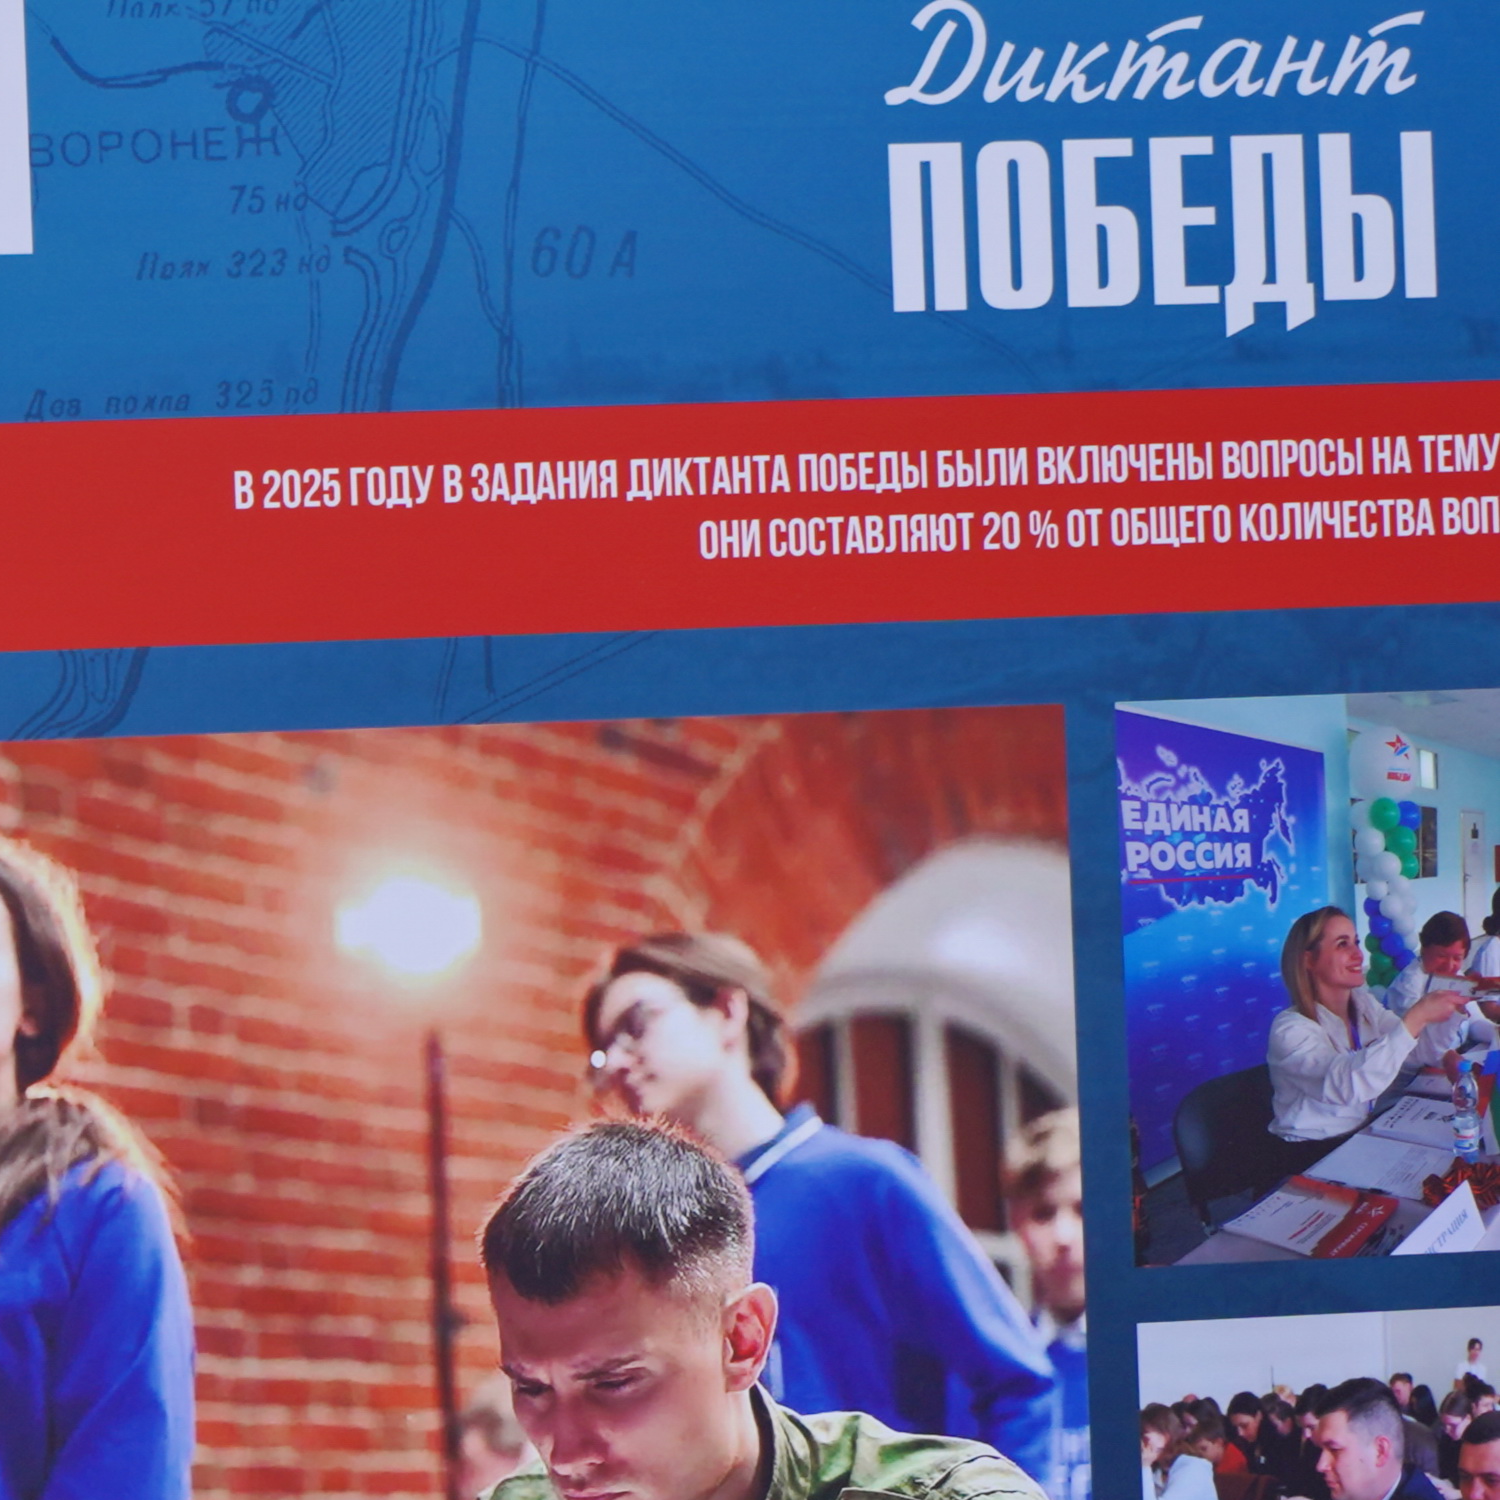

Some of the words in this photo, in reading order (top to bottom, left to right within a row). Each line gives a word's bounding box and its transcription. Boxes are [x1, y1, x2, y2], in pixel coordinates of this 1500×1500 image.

[883, 0, 1424, 106] Диктант
[29, 122, 283, 168] ВОРОНЕЖ
[229, 185, 265, 216] 75
[530, 225, 595, 280] 60
[887, 131, 1438, 338] ПОБЕДЫ
[227, 248, 287, 277] 323
[233, 470, 255, 510] В
[261, 467, 342, 509] 2025
[349, 464, 435, 509] ГОДУ
[442, 462, 465, 504] В
[470, 458, 619, 505] ЗАДАНИЯ
[626, 453, 791, 501] ДИКТАНТА
[797, 449, 928, 494] ПОБЕДЫ
[936, 448, 1029, 490] БЫЛИ
[1036, 441, 1214, 487] ВКЛЮЧЕНЫ
[1222, 437, 1364, 480] ВОПРОСЫ
[1372, 434, 1413, 475] НА
[1418, 432, 1500, 473] ТЕМУ
[698, 519, 761, 561] ОНИ
[768, 511, 975, 558] СОСТАВЛЯЮТ
[981, 510, 1021, 552] 20
[1028, 509, 1060, 549] %
[1066, 508, 1104, 548] ОТ
[1110, 504, 1232, 548] ОБЩЕГО
[1239, 498, 1436, 542] КОЛИЧЕСТВА
[1441, 496, 1500, 536] ВОП
[1121, 799, 1250, 836] ЕДИНАЯ
[1125, 841, 1252, 872] РОССИЯ
